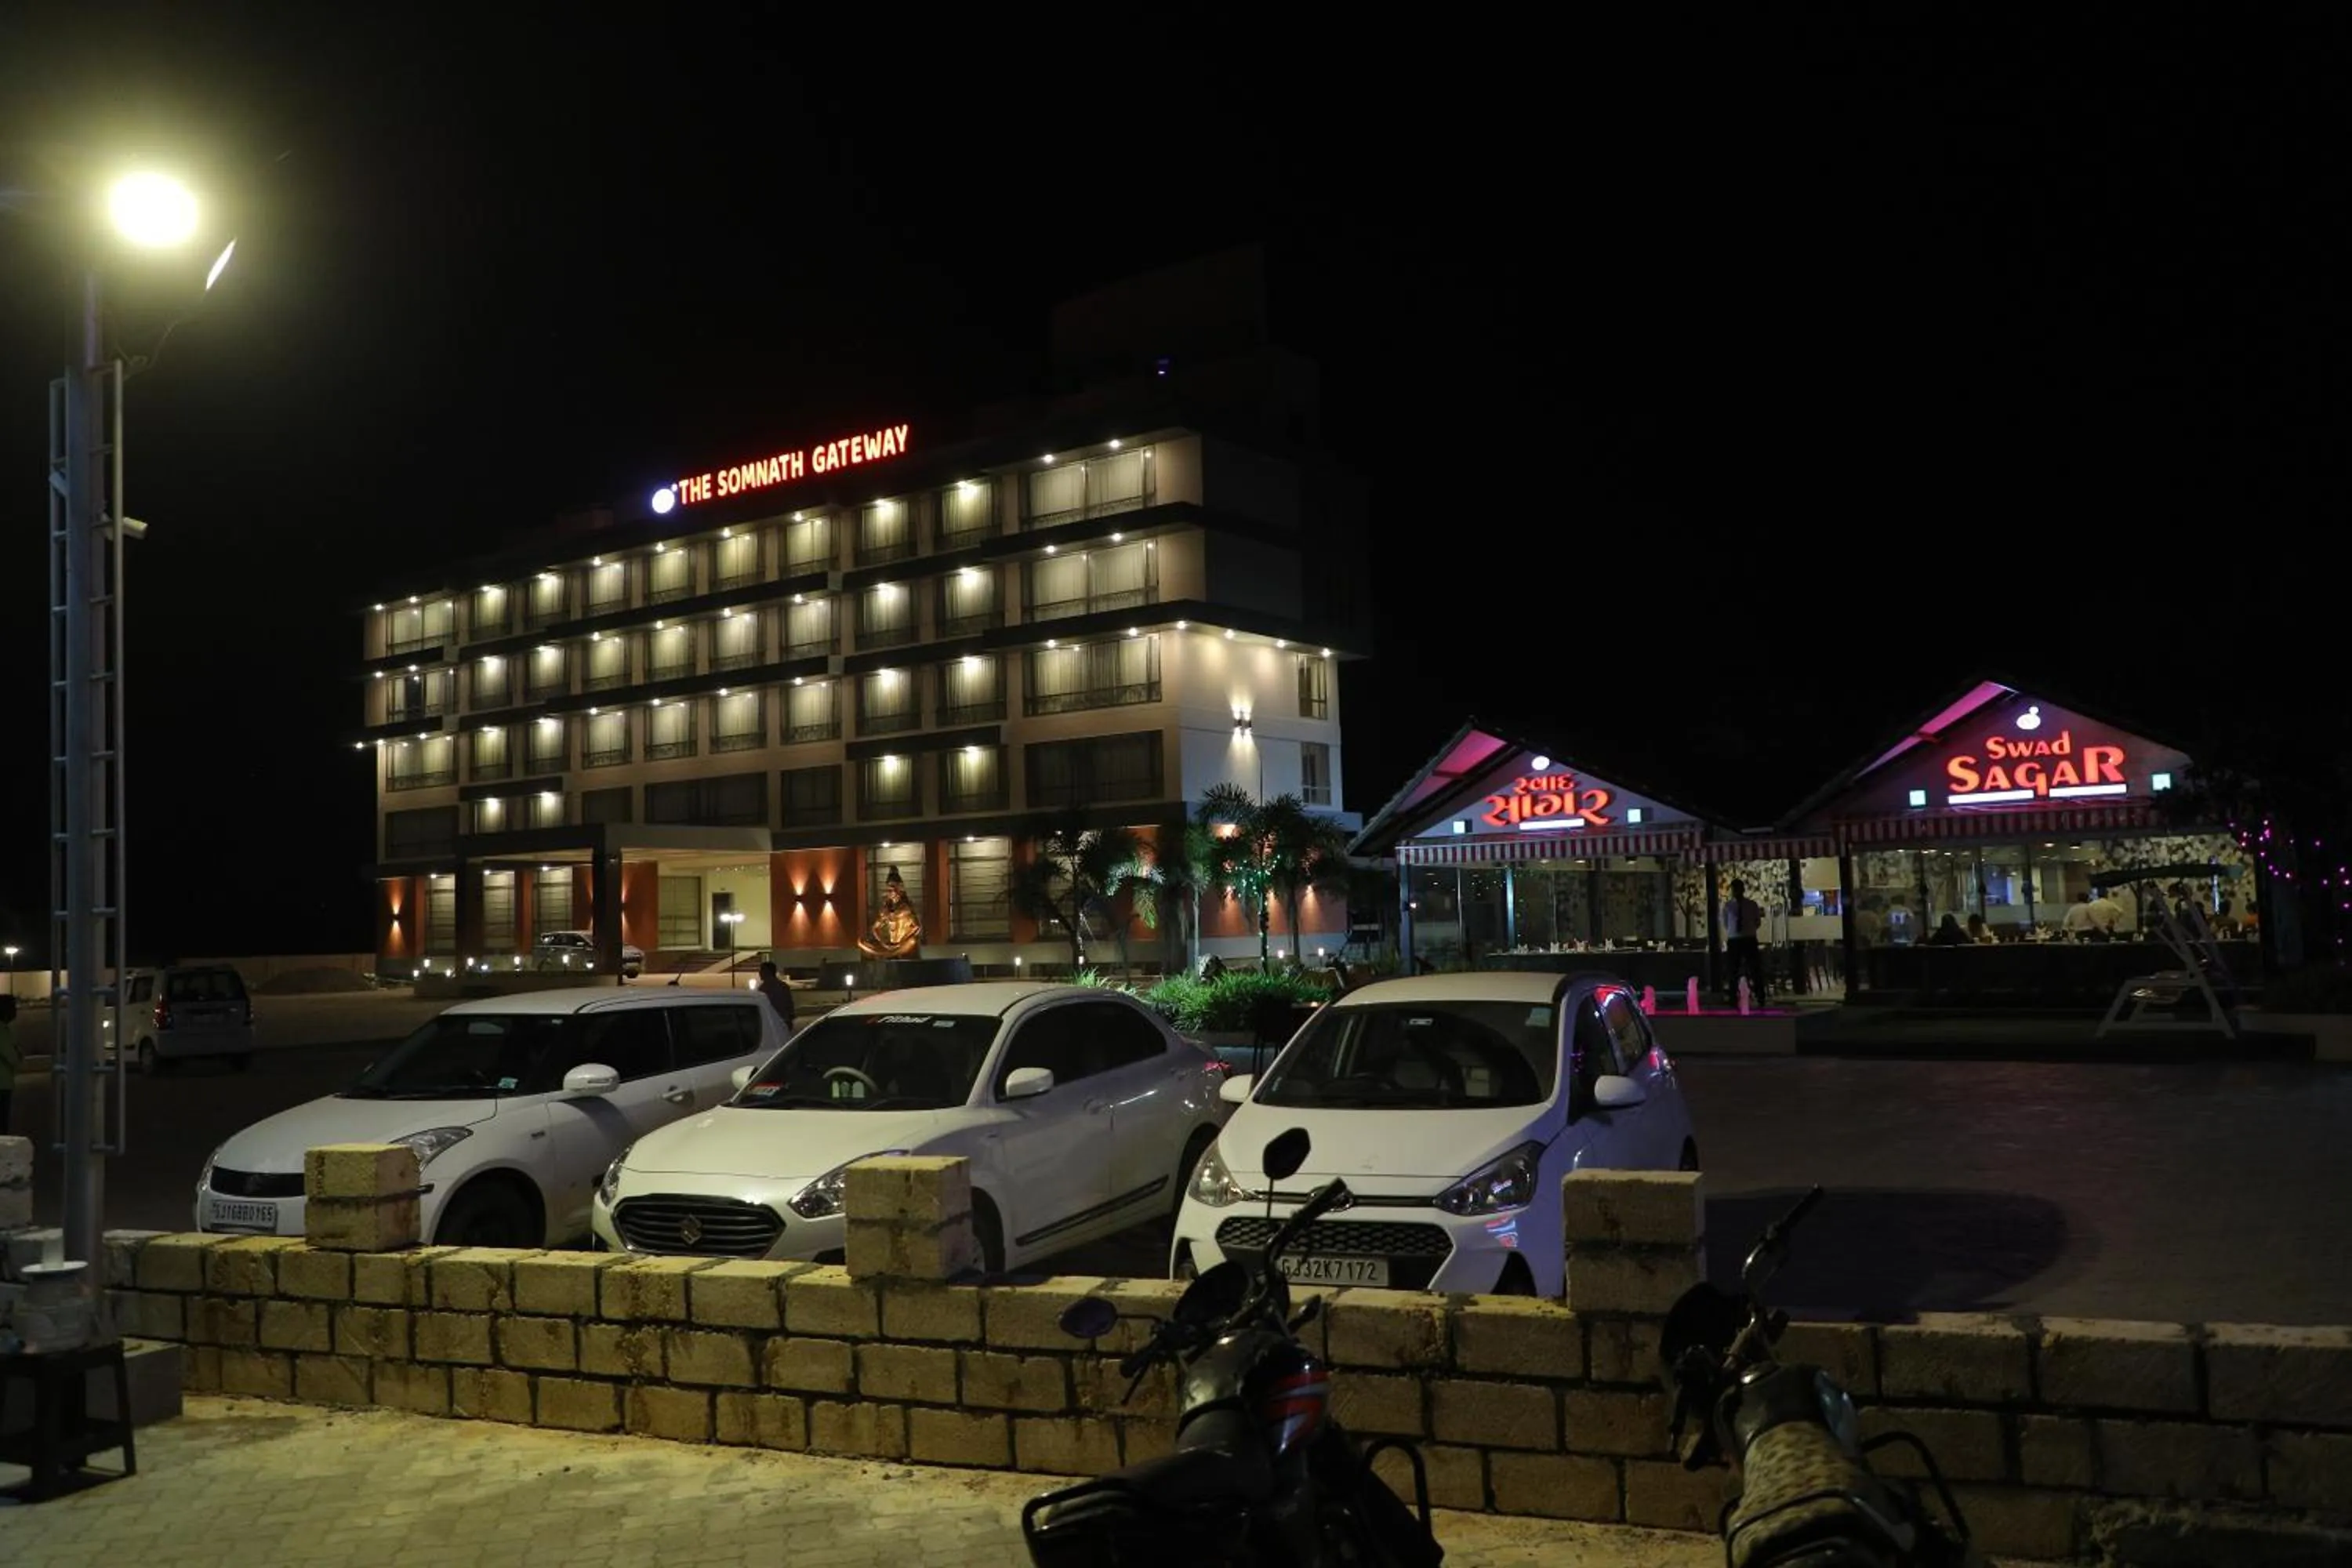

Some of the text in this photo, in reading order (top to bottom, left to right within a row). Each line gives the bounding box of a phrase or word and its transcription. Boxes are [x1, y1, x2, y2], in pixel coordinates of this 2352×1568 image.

[679, 424, 909, 505] THE SOMNATH GATEWAY
[1947, 746, 2125, 796] SAGAR
[1481, 789, 1610, 828] સાગર
[1282, 1258, 1378, 1281] GJ32K7172
